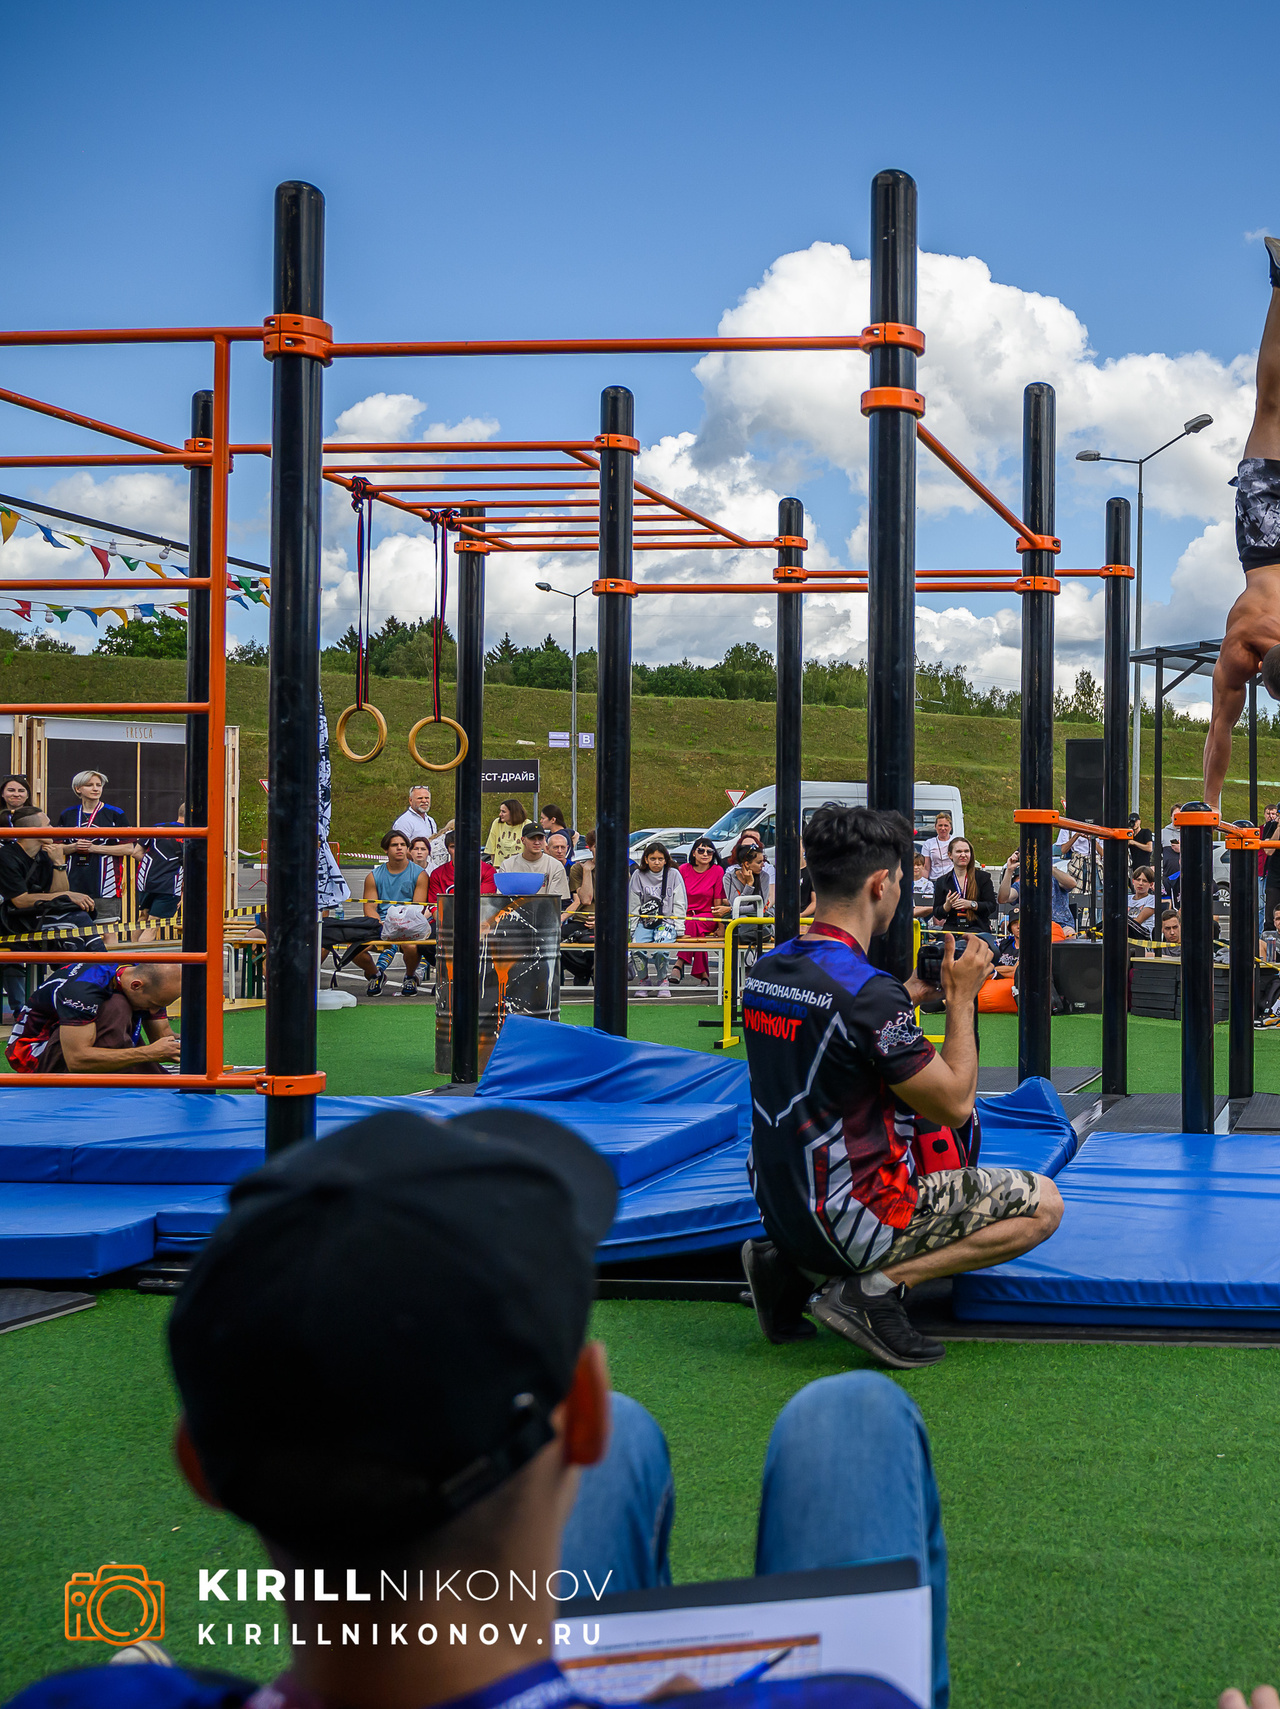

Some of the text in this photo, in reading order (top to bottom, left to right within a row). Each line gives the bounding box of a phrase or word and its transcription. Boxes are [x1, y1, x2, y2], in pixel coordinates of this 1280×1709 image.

[126, 727, 153, 739] FRESCA
[481, 771, 535, 782] ЕСТ-ДРАЙВ
[744, 1007, 803, 1042] WORKOUT
